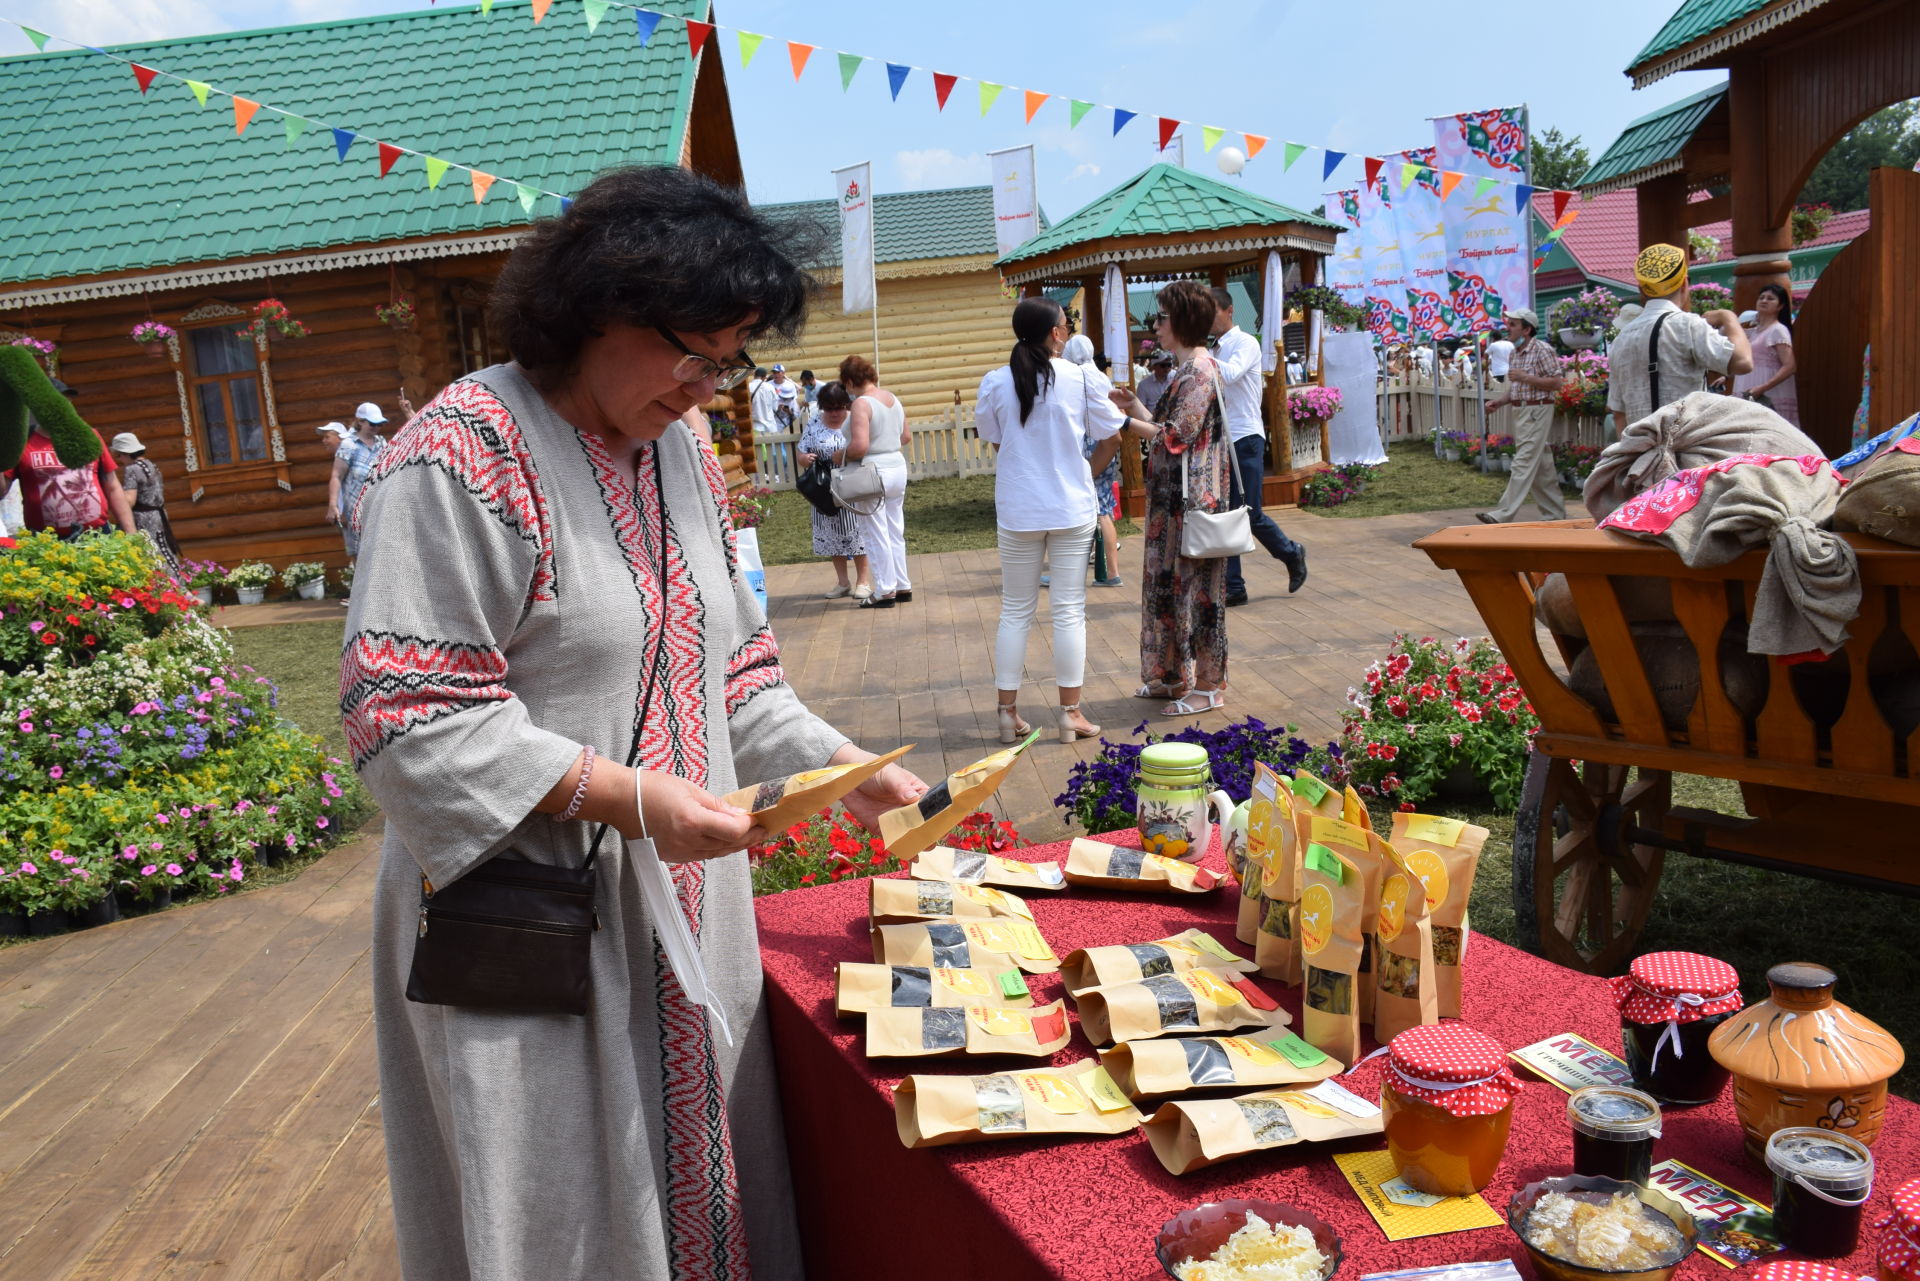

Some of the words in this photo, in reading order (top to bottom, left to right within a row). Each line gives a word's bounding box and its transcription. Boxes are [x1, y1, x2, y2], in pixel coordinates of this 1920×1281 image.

[1549, 1038, 1633, 1086] МЁД
[1363, 1183, 1394, 1217] ЛИПОВЫЙ
[1648, 1167, 1748, 1223] МЁД
